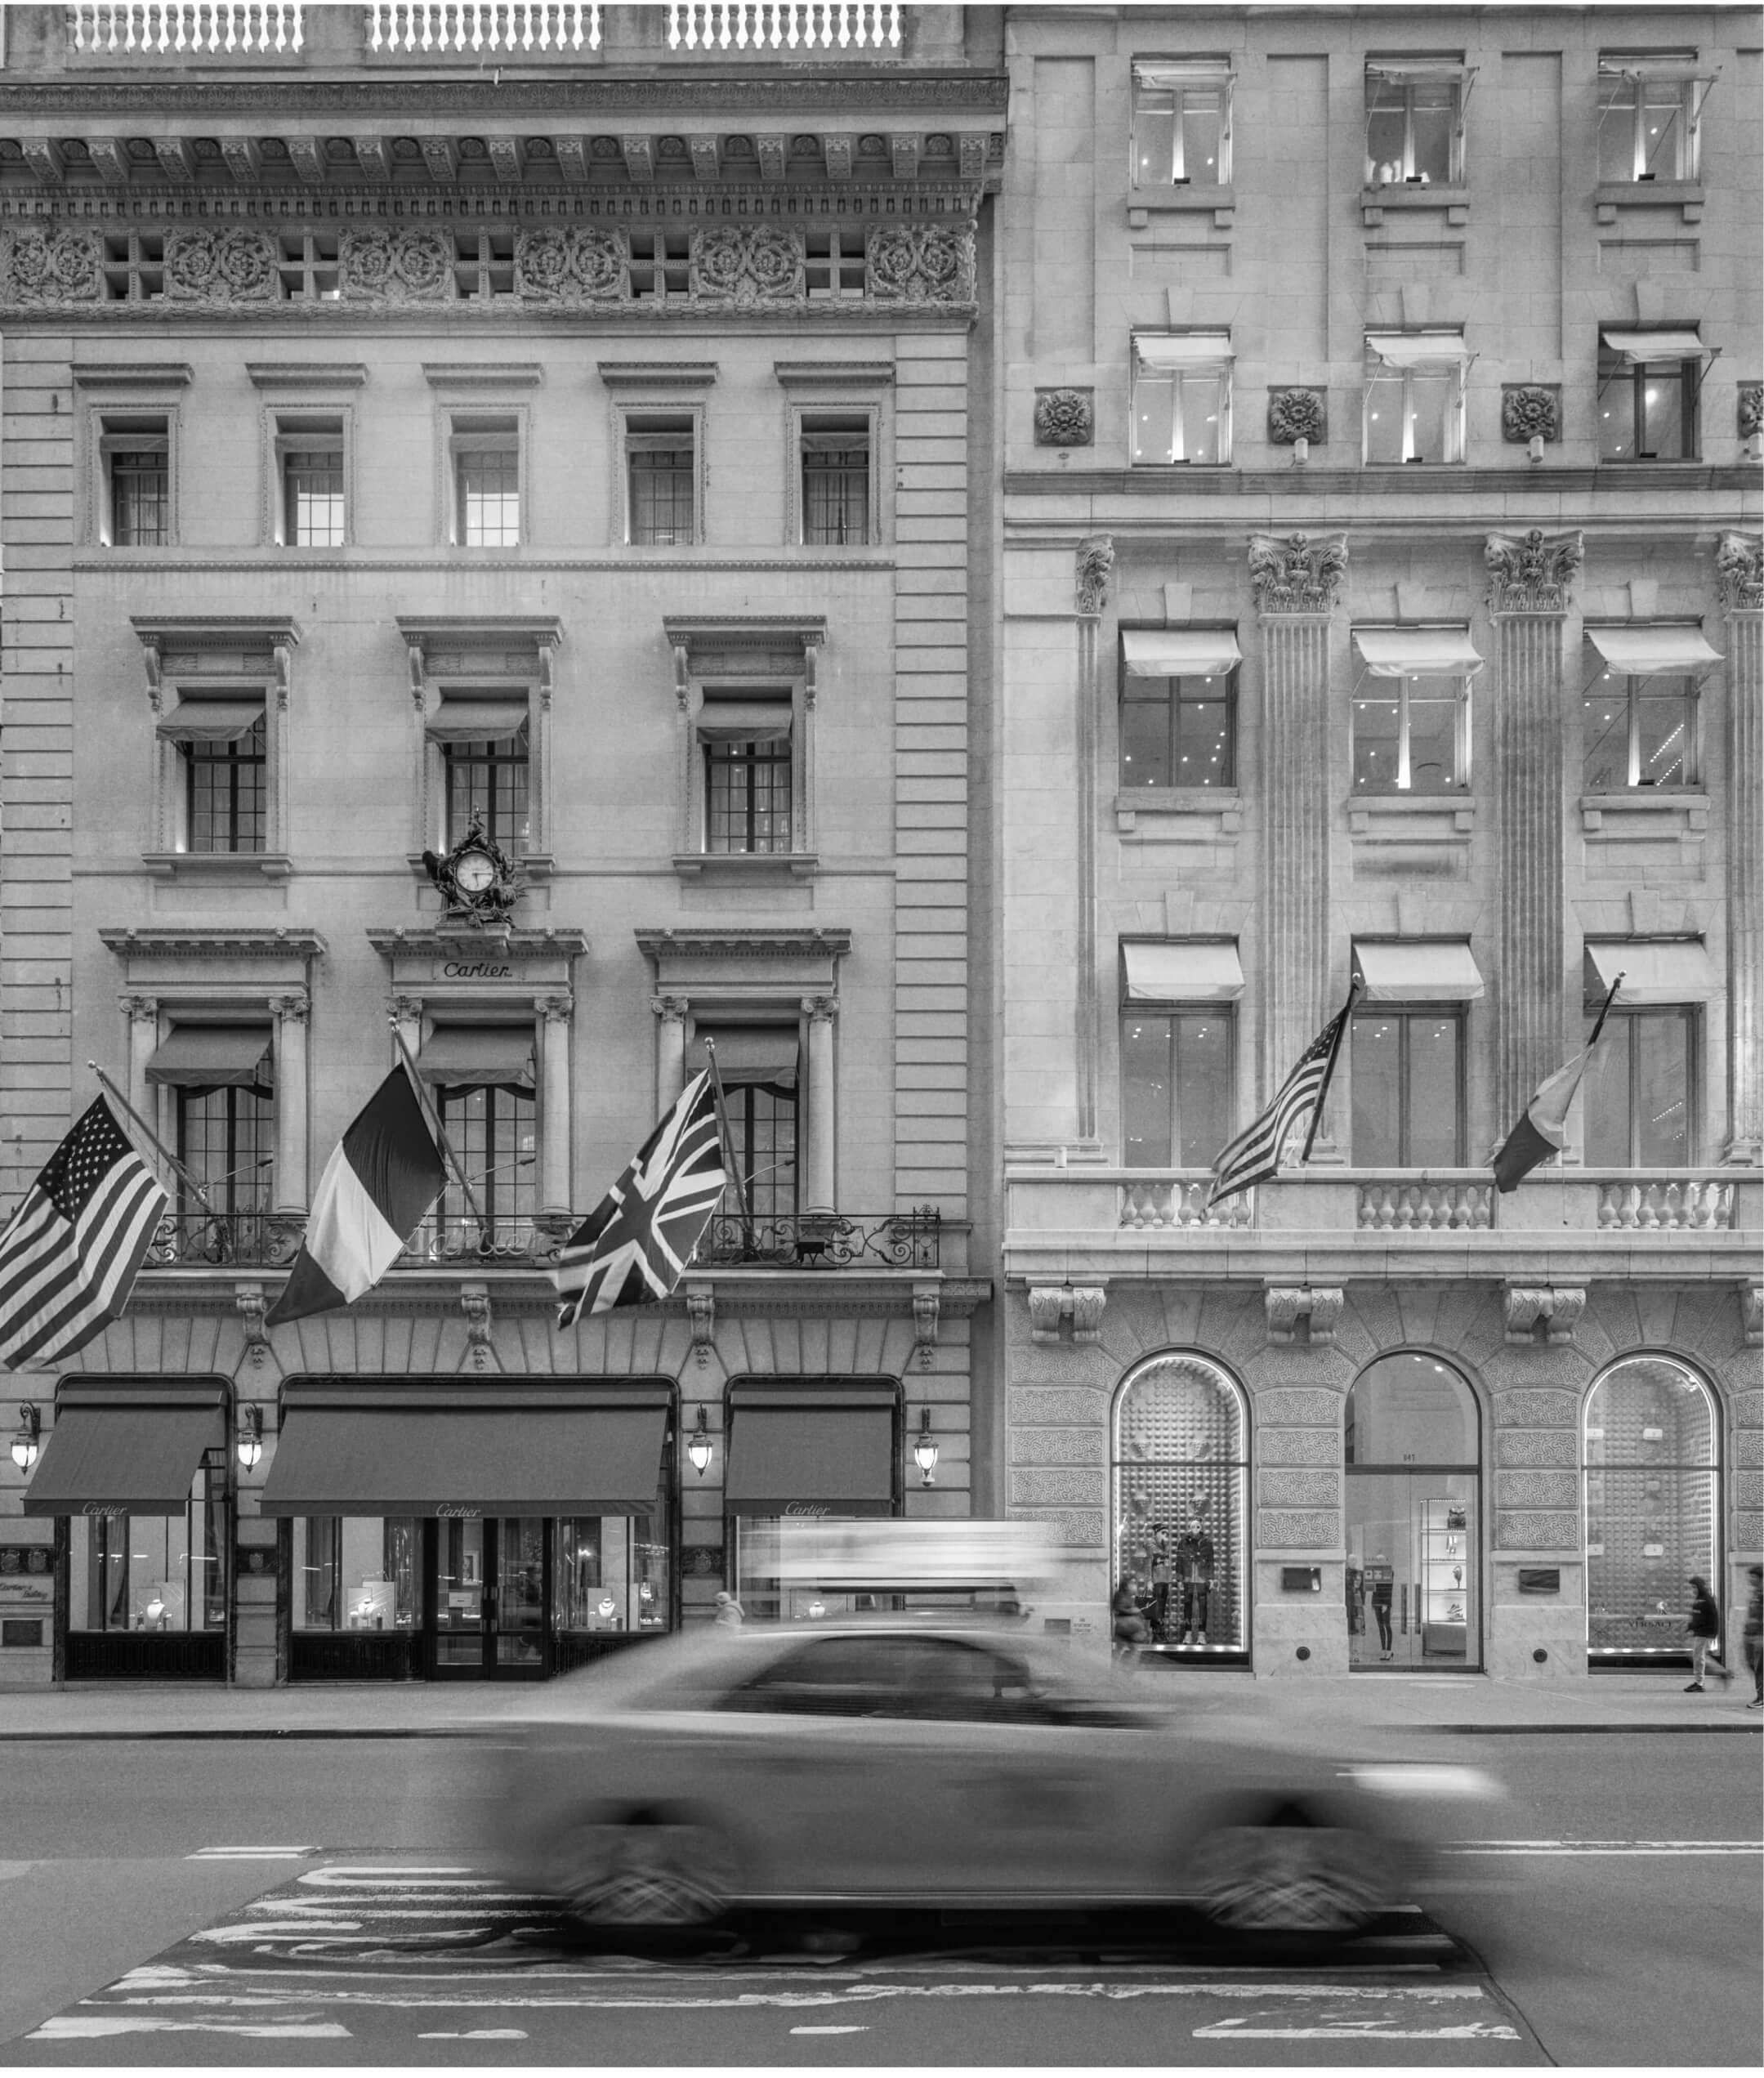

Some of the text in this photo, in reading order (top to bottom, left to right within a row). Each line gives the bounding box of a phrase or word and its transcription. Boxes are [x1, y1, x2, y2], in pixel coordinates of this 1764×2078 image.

[444, 962, 512, 977] Cartier
[82, 1501, 127, 1516] Cartier
[435, 1503, 481, 1517] Cartier
[785, 1501, 831, 1516] Cartier
